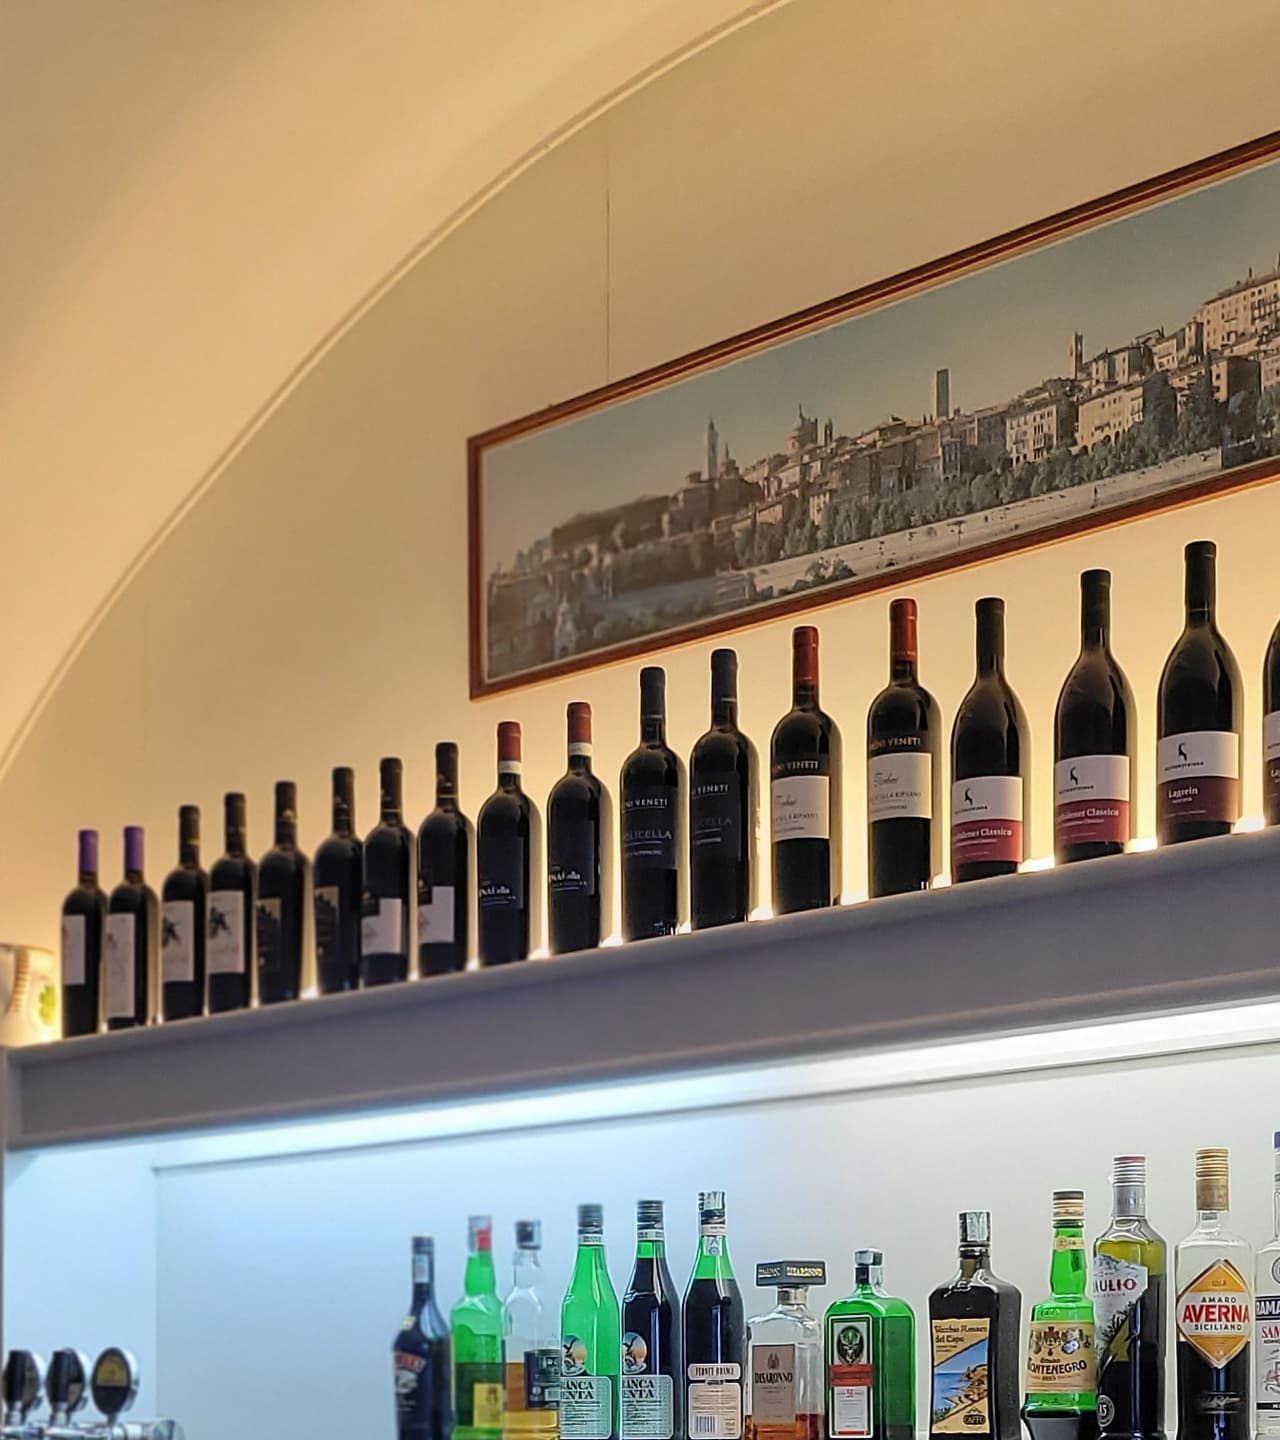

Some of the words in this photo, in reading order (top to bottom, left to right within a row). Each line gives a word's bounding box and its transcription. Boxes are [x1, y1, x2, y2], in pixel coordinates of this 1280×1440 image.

[1168, 786, 1199, 799] Lagrein
[634, 798, 668, 806] VENETI
[1086, 807, 1120, 817] Classico
[980, 827, 1013, 836] Classico
[1200, 1296, 1237, 1304] AMARO
[1182, 1304, 1250, 1323] AVERNA
[1193, 1323, 1242, 1331] SICILIANO
[754, 1371, 793, 1385] DISARONNO
